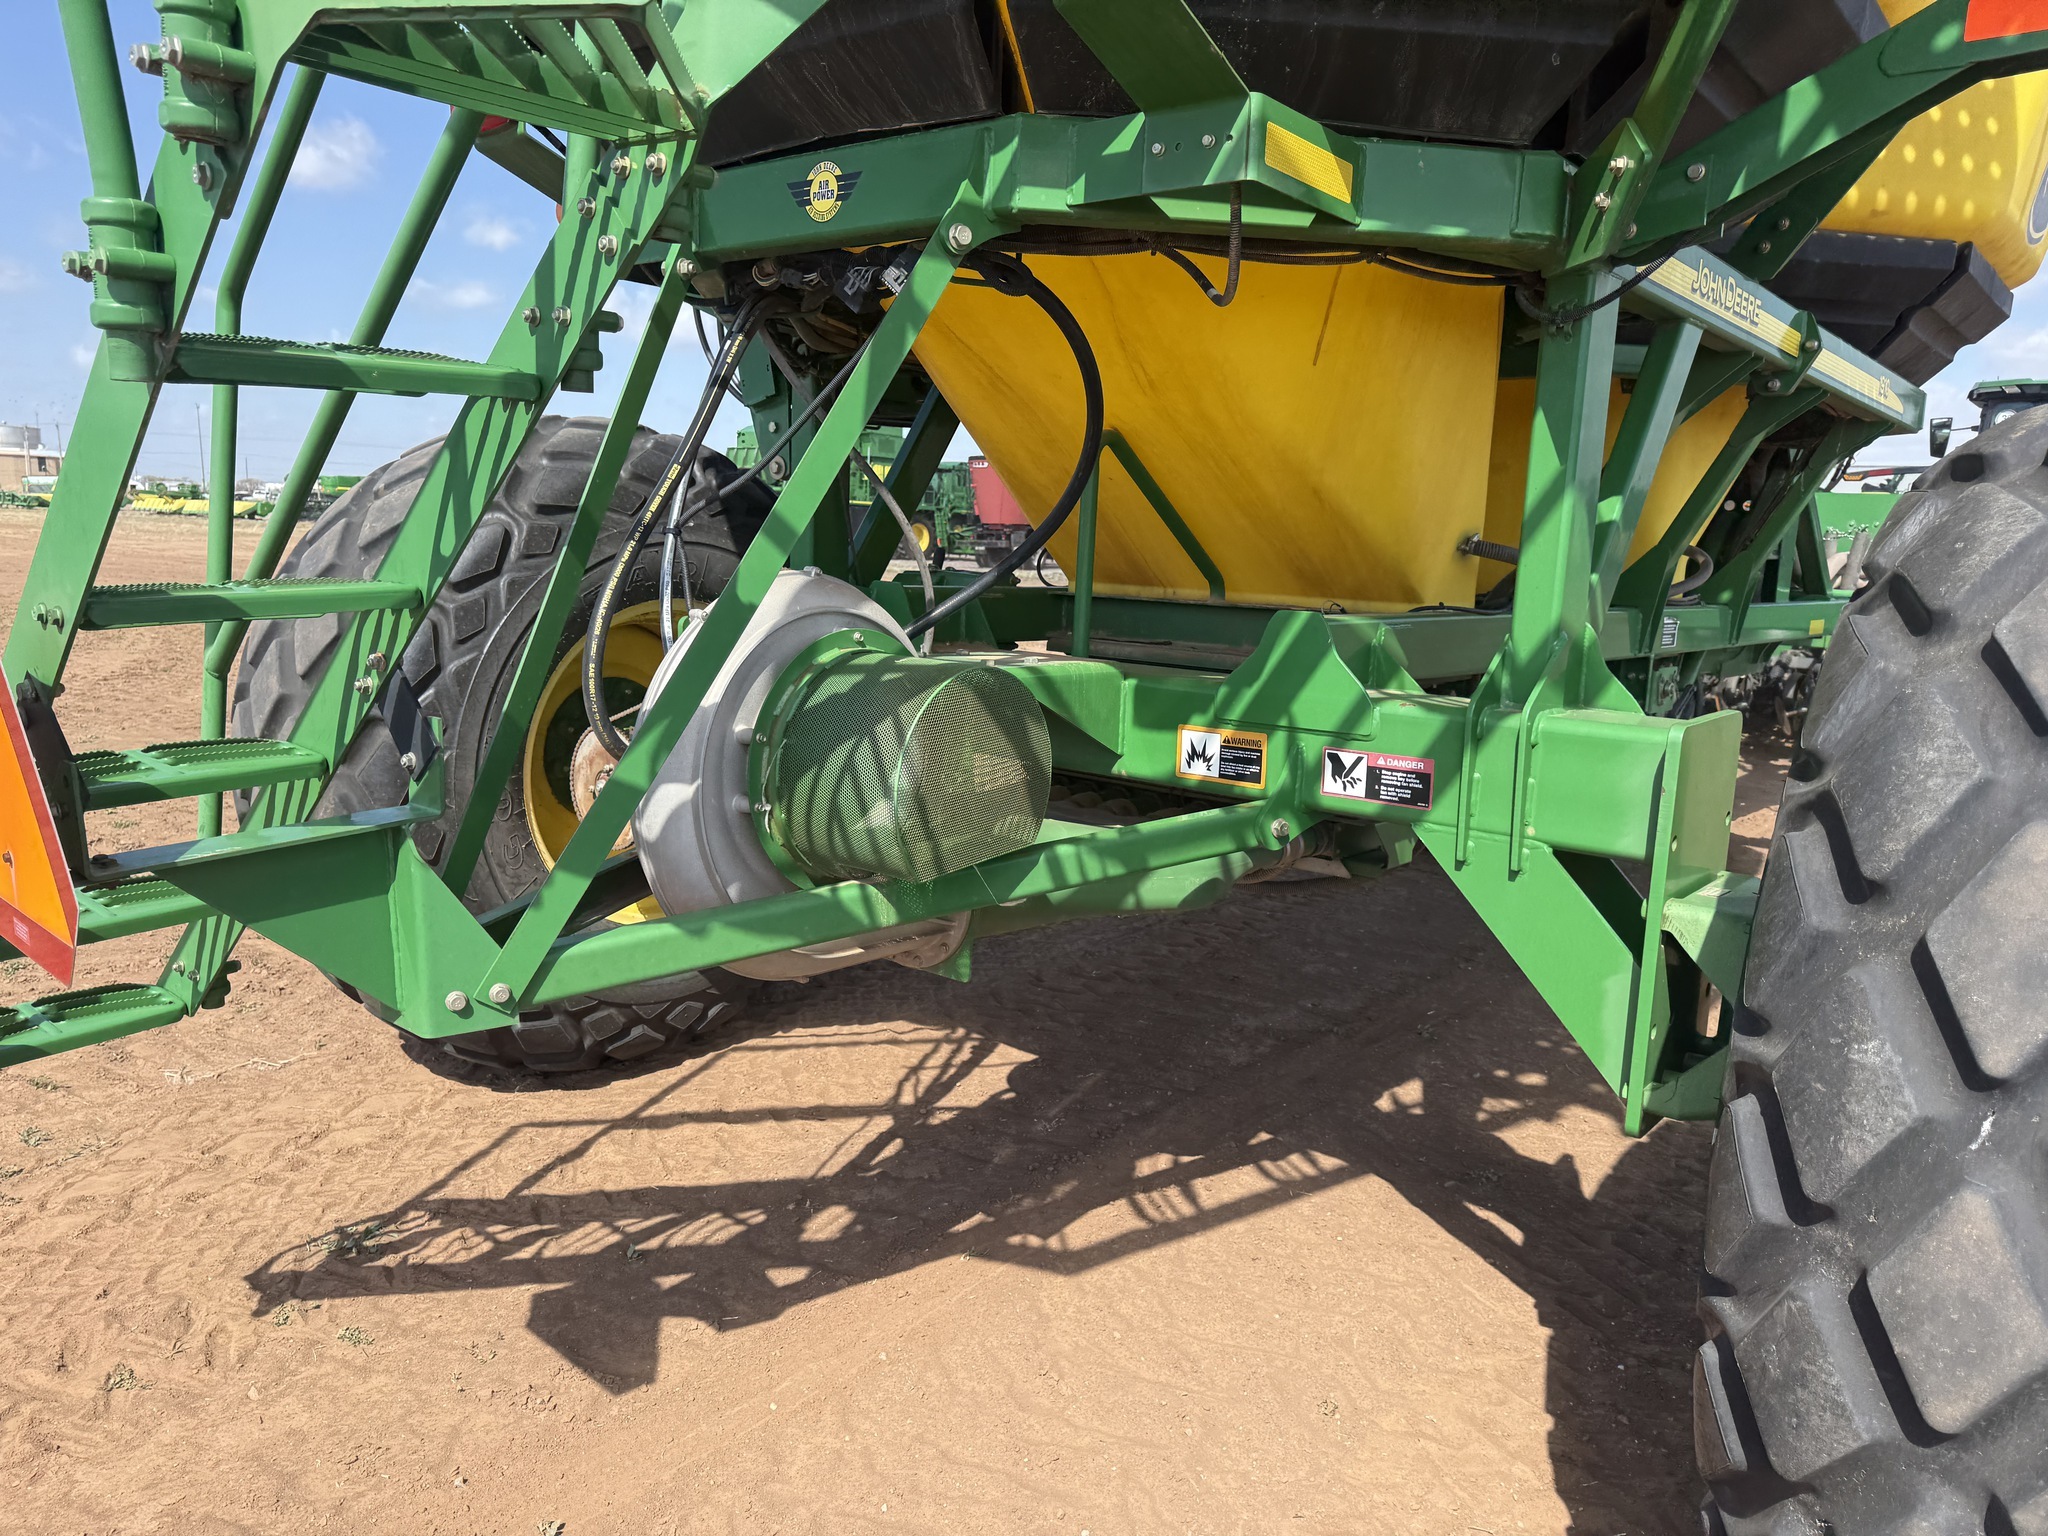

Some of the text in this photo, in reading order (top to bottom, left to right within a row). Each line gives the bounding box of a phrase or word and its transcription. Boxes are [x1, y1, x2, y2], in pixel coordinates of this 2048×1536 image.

[818, 180, 829, 190] AIR
[813, 189, 834, 201] POWER
[1691, 259, 1762, 328] JOHN DEERE
[1231, 737, 1262, 748] WARNING
[1387, 759, 1424, 769] DANGER
